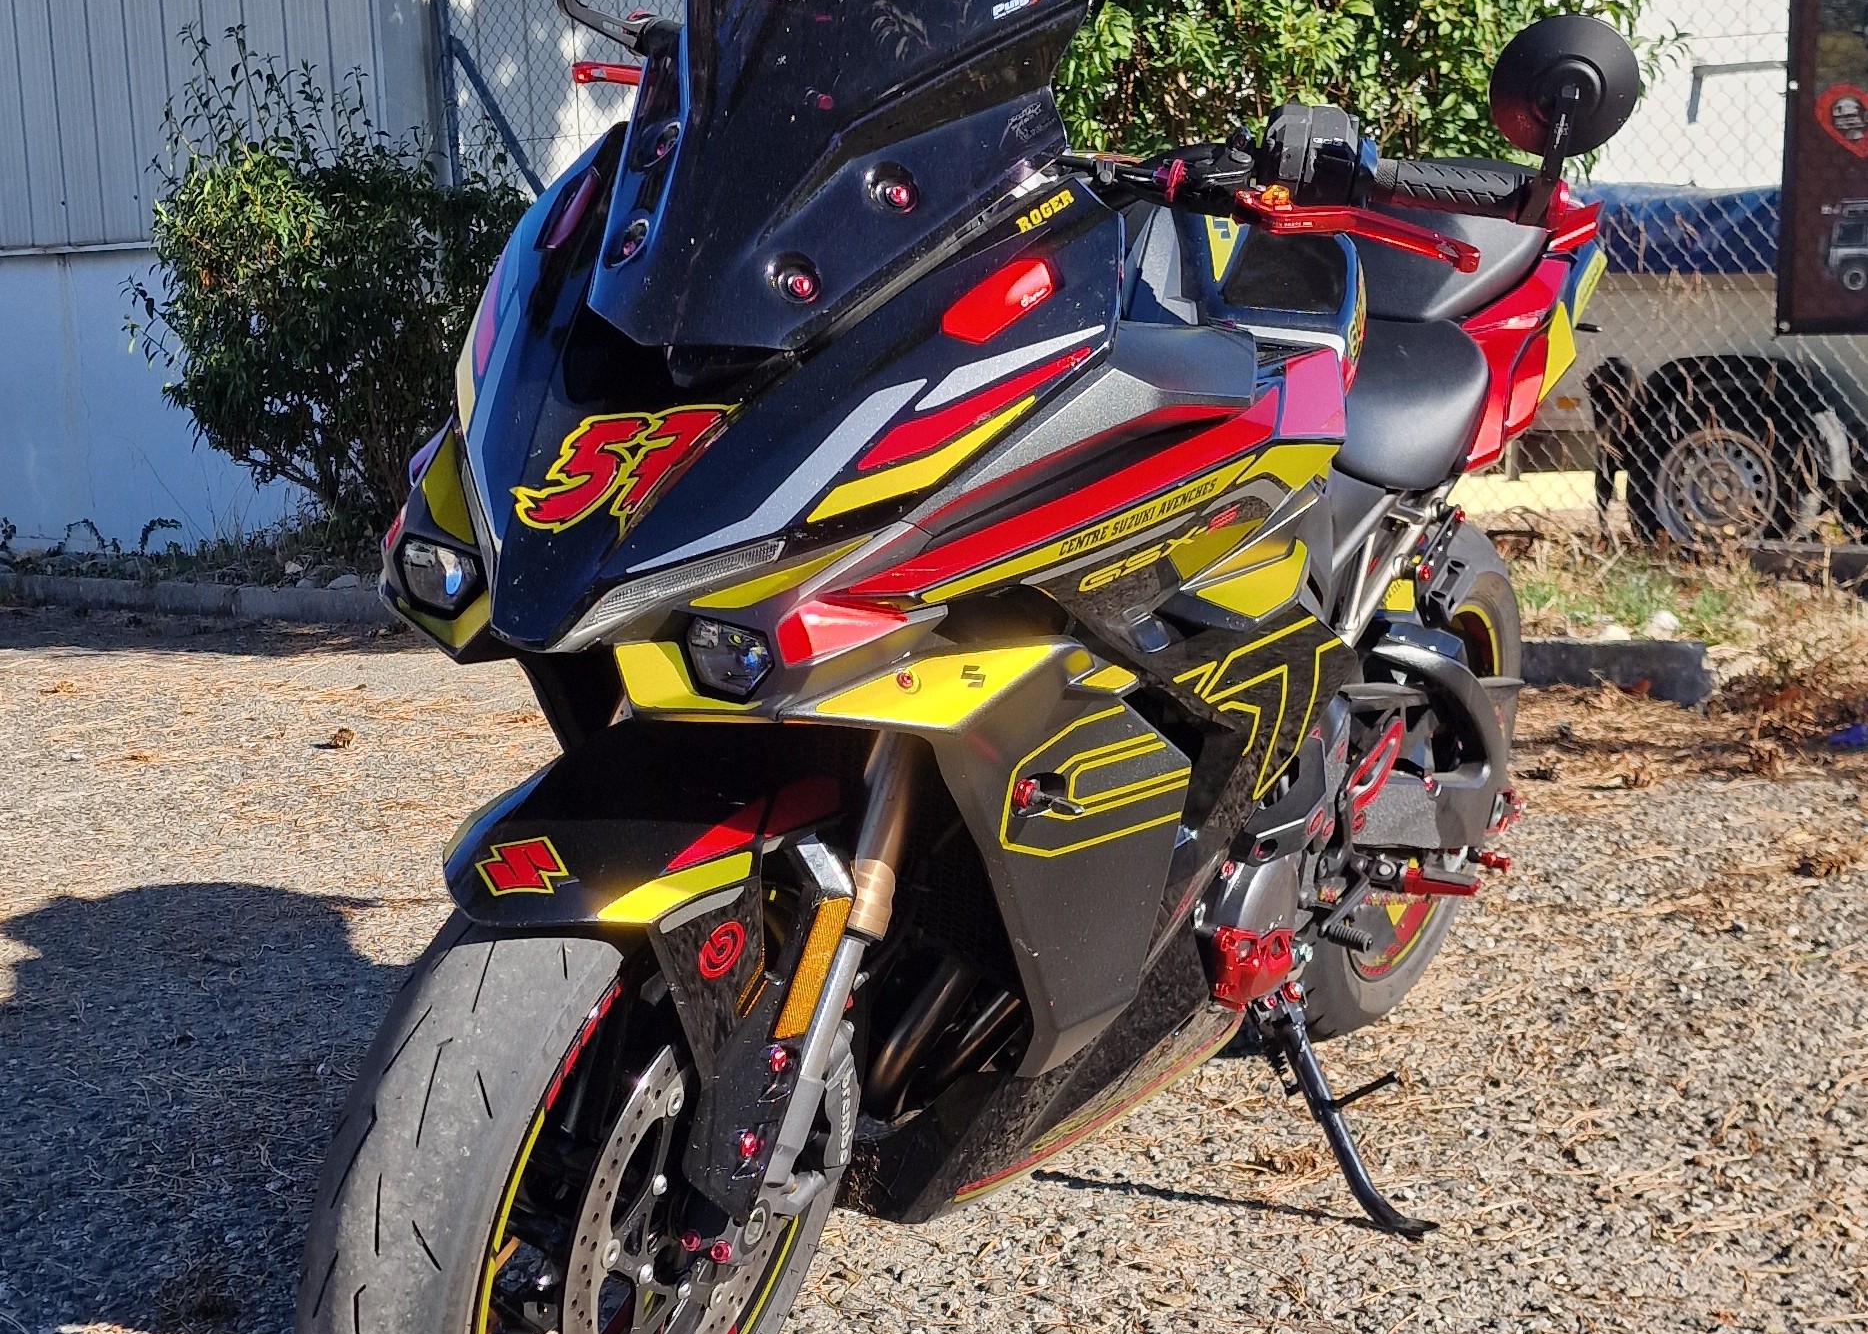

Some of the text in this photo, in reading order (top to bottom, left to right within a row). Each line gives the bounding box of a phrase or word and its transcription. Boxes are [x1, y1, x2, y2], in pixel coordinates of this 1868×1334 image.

[1015, 189, 1075, 234] ROGER
[1058, 478, 1219, 557] CENTRE SUZUKI AVENCHES
[840, 1067, 854, 1166] brembo
